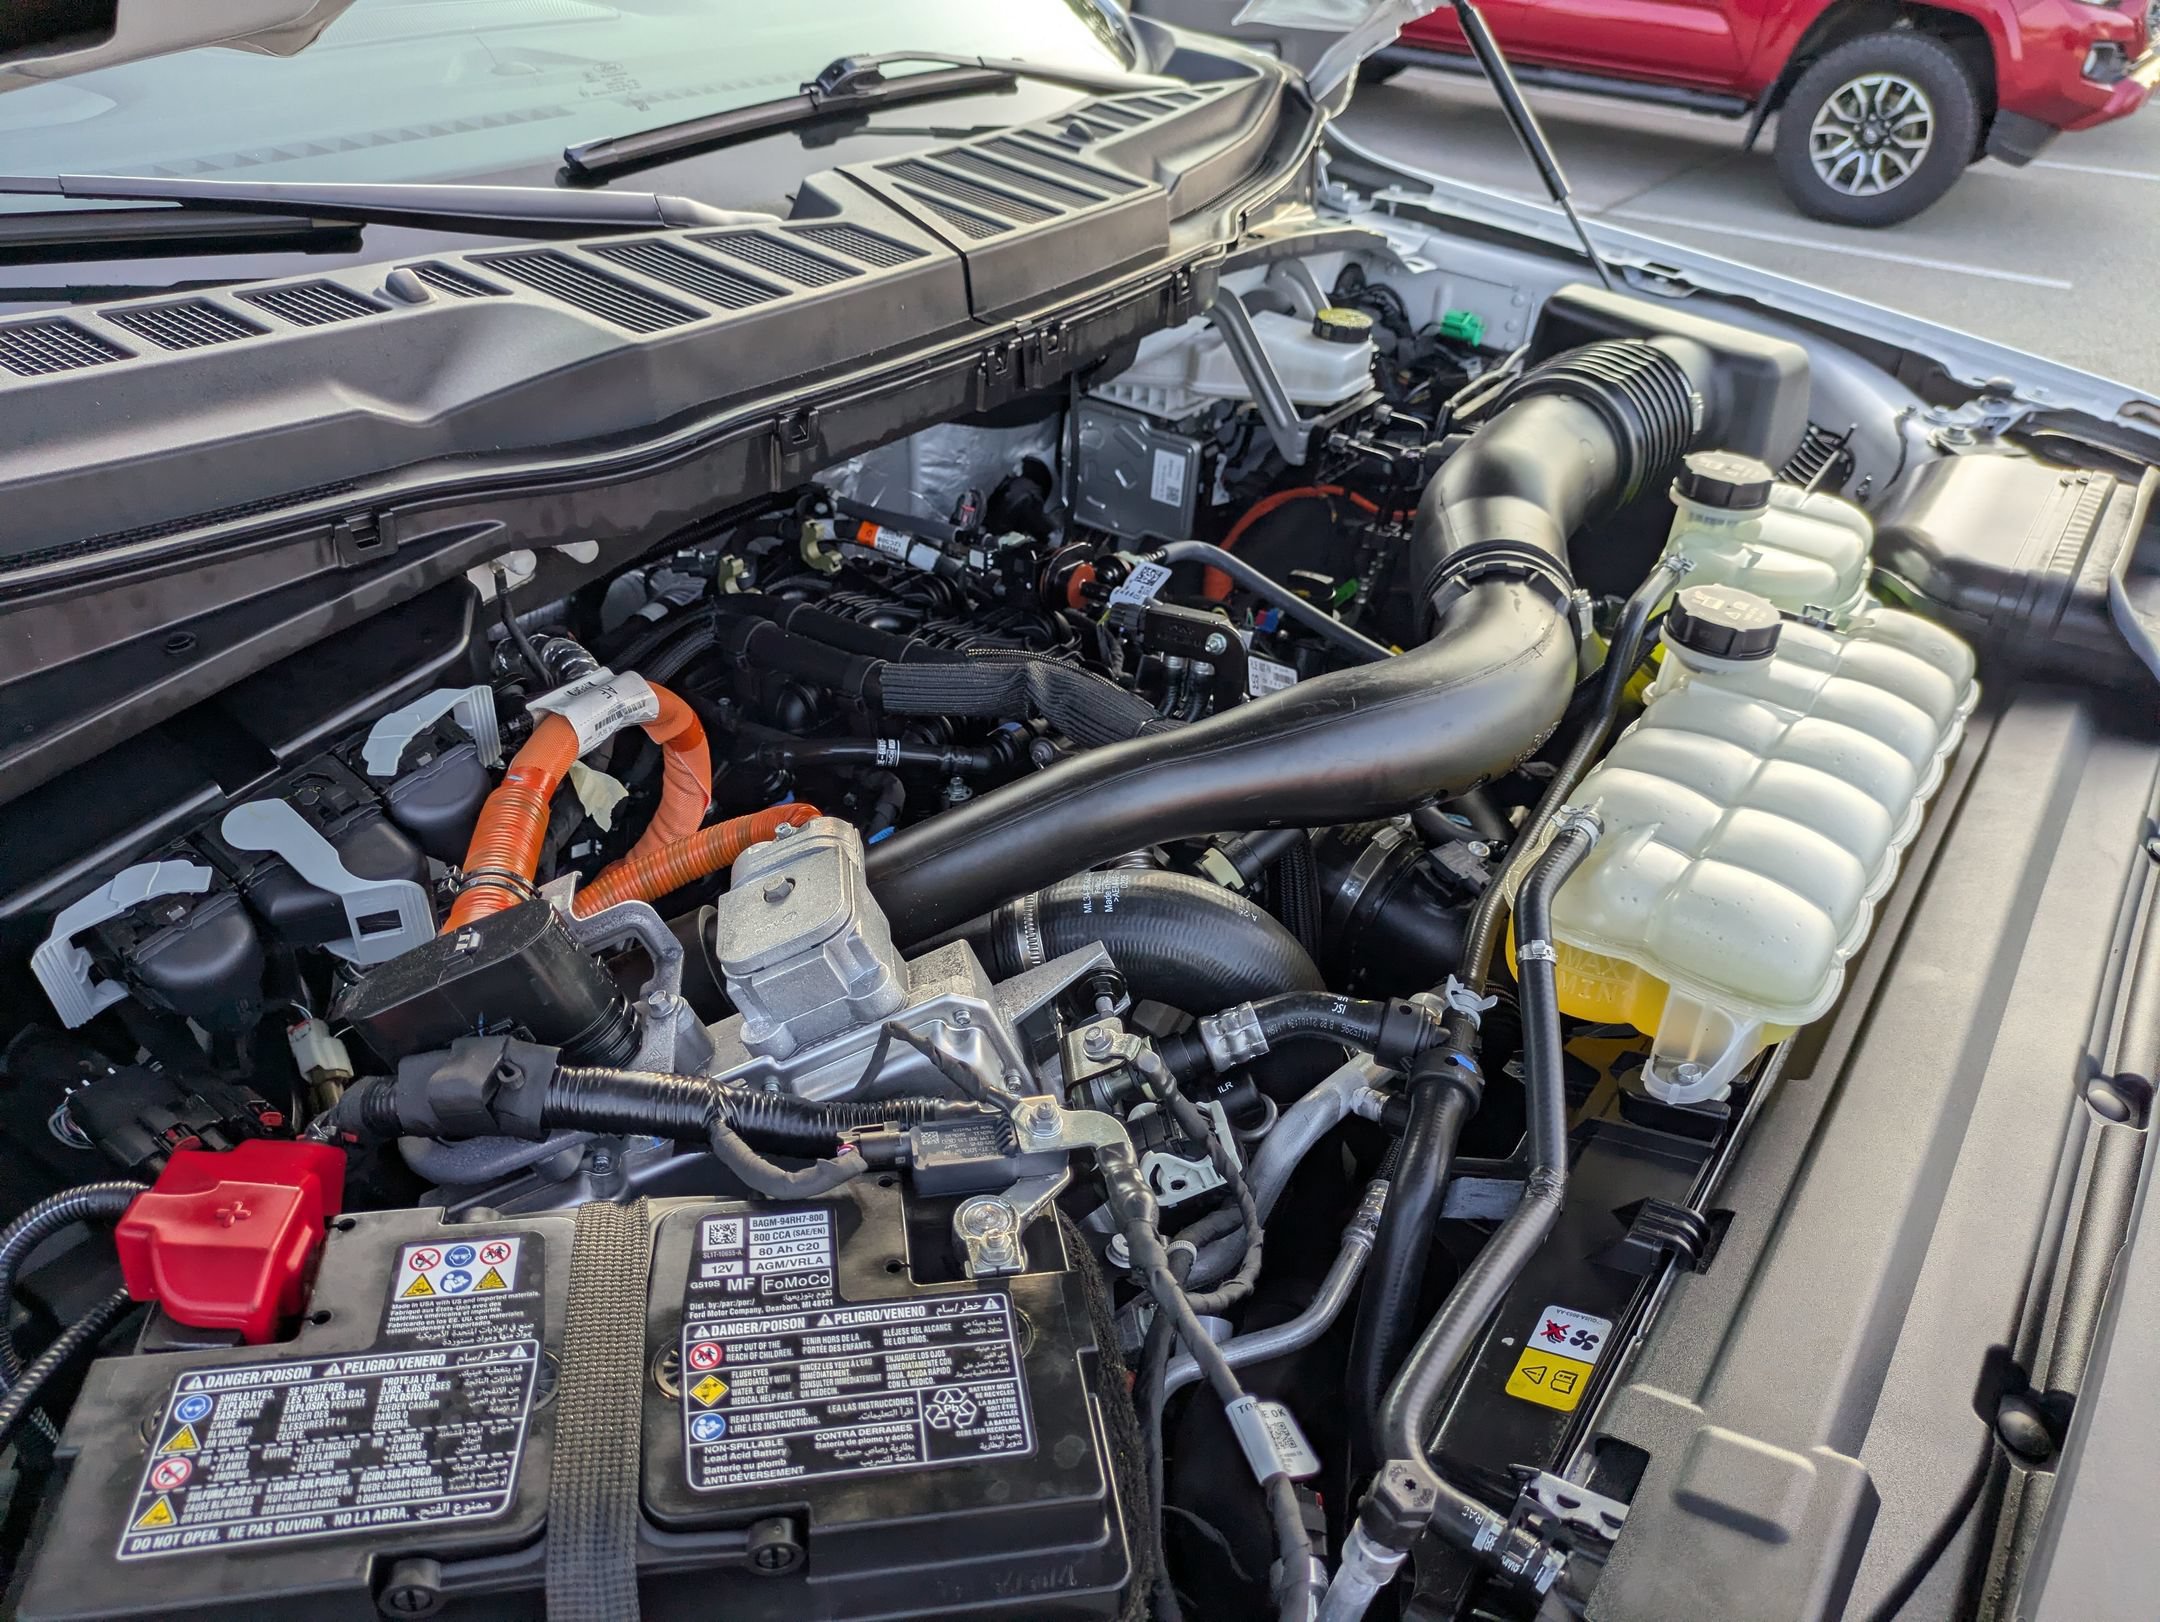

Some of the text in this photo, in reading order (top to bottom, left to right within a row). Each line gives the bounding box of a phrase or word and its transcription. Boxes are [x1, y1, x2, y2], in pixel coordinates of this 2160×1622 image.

[1217, 1081, 1234, 1094] ILR
[753, 1214, 824, 1227] BAGM-94RH7-800
[754, 1228, 825, 1241] 800 CCA (SAE/EN)
[759, 1242, 819, 1256] 80 Ah C20
[712, 1264, 734, 1274] 12V
[756, 1256, 824, 1271] AGM/VRLA
[727, 1278, 756, 1291] MF
[765, 1274, 829, 1290] FoMoCo
[690, 1311, 705, 1319] Ford
[707, 1309, 727, 1317] Motor
[712, 1305, 926, 1337] DANGER/POISON PELIGRO/VENENO
[911, 1325, 923, 1334] DEL
[924, 1323, 952, 1333] ALCANCE
[802, 1333, 860, 1345] TENIR HORS DE LA
[884, 1338, 893, 1346] DE
[894, 1337, 906, 1345] LOS
[726, 1341, 781, 1352] KEEP OUT OF THE
[828, 1344, 841, 1352] DES
[726, 1352, 749, 1362] REACH
[749, 1351, 758, 1360] OF
[930, 1350, 946, 1358] OJOS
[343, 1354, 446, 1375] PELIGRO/VENENO
[205, 1366, 312, 1388] DANGER/POISON
[731, 1368, 768, 1378] FLUSH EYES
[383, 1374, 437, 1386] PROTEJA LOS
[288, 1388, 300, 1396] SE
[756, 1386, 768, 1394] GET
[379, 1392, 430, 1404] EXPLOSIVOS
[759, 1394, 776, 1403] HELP
[217, 1400, 264, 1412] EXPLOSIVE
[377, 1400, 439, 1412] PUEDEN CAUSAR
[827, 1405, 842, 1414] LEA
[842, 1403, 857, 1412] LAS
[944, 1405, 959, 1413] Pb
[214, 1409, 260, 1420] GASES CAN
[281, 1411, 329, 1423] CAUSER DES
[729, 1415, 751, 1424] READ
[210, 1420, 237, 1430] CAUSE
[729, 1424, 747, 1434] LIRE
[748, 1422, 762, 1432] LES
[815, 1425, 912, 1441] CONTRA DERRAMES
[204, 1439, 218, 1448] OR
[372, 1433, 424, 1448] NO CHISPAS
[705, 1438, 784, 1454] NON-SPILLABLE
[391, 1442, 422, 1452] FLAMAS
[198, 1452, 250, 1466] NO SPARKS
[390, 1451, 428, 1462] CIGARROS
[729, 1451, 751, 1460] Acid
[753, 1447, 787, 1459] Battery
[216, 1462, 247, 1471] FLAMES
[703, 1475, 727, 1486] ANTI
[131, 1507, 410, 1551] DO NOT OPEN. NE PAS OUVRIR. NO LA ABRA.
